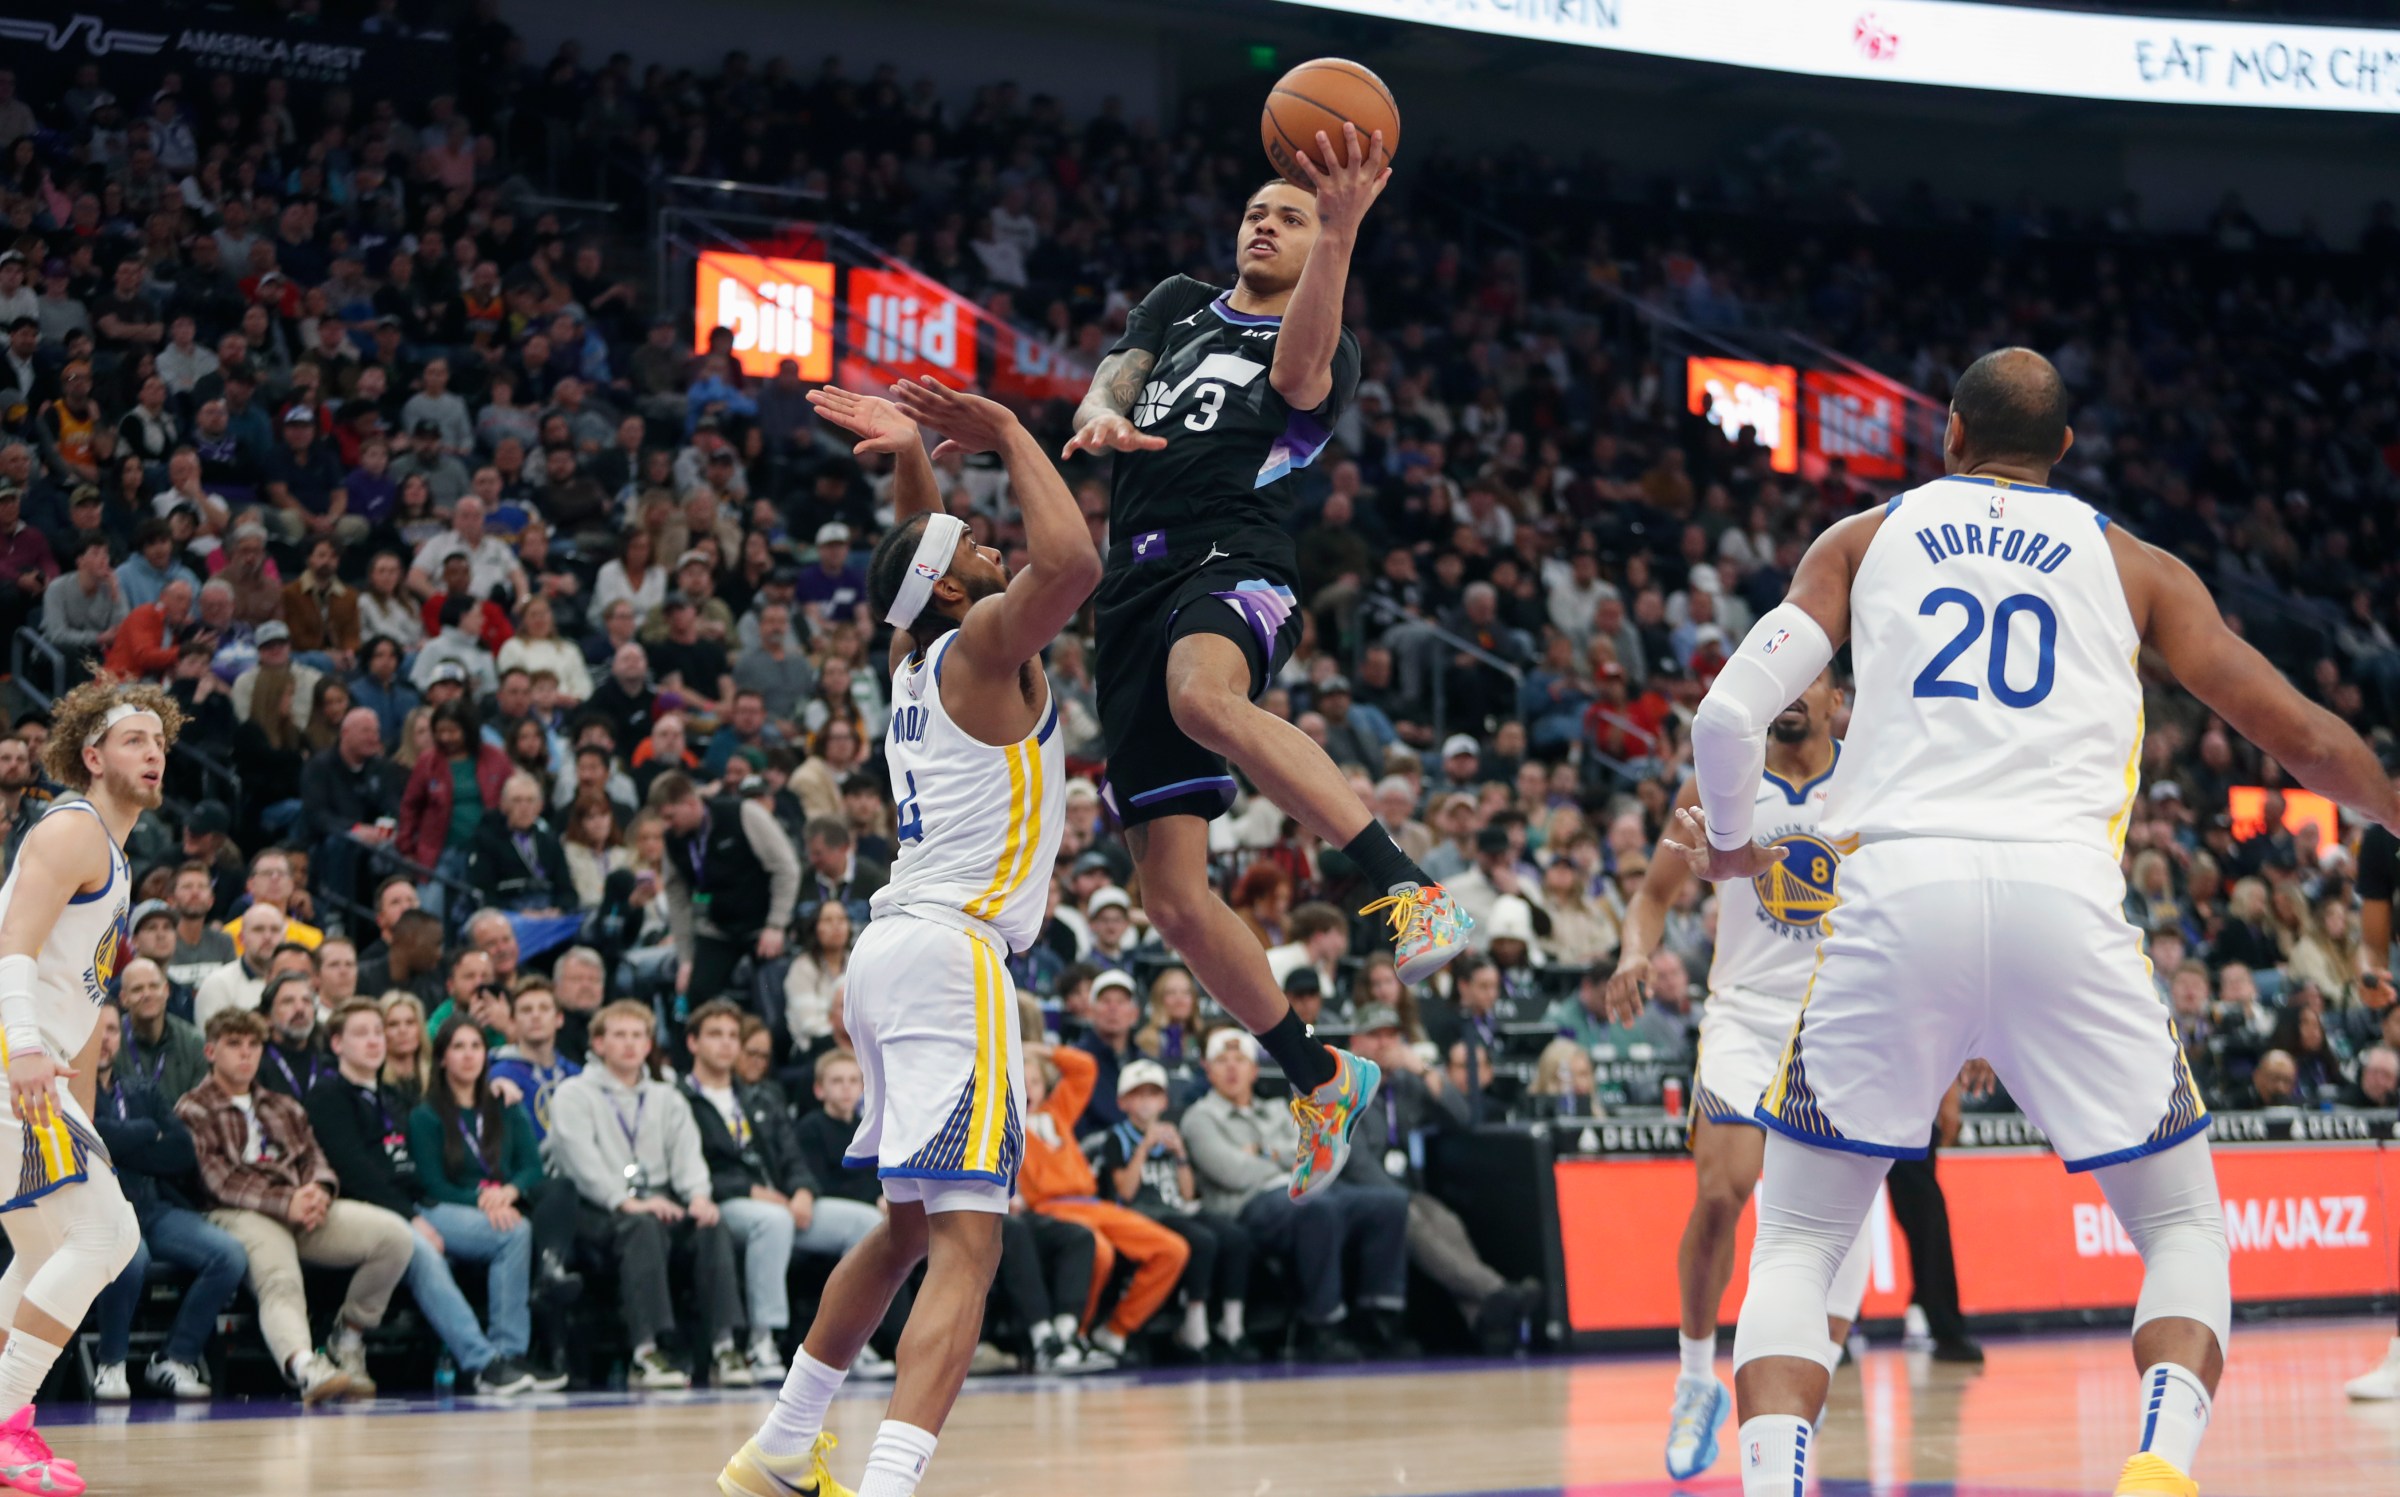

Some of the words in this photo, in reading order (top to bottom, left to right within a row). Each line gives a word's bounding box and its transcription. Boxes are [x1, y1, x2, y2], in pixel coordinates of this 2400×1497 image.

[177, 29, 290, 61] AMERICA
[292, 42, 366, 70] FIRST
[2133, 38, 2214, 84] EAT
[2228, 42, 2316, 88] MOR
[718, 277, 813, 356] bill
[1184, 382, 1226, 431] 3
[1915, 523, 2072, 574] HORFORD
[1912, 587, 2057, 708] 20
[898, 769, 924, 844] 4
[1758, 822, 1802, 845] OLDEN
[1811, 856, 1829, 884] 8
[1755, 906, 1824, 941] WARRI
[1602, 1126, 1684, 1151] DELTA
[2309, 1114, 2370, 1140] DELTA
